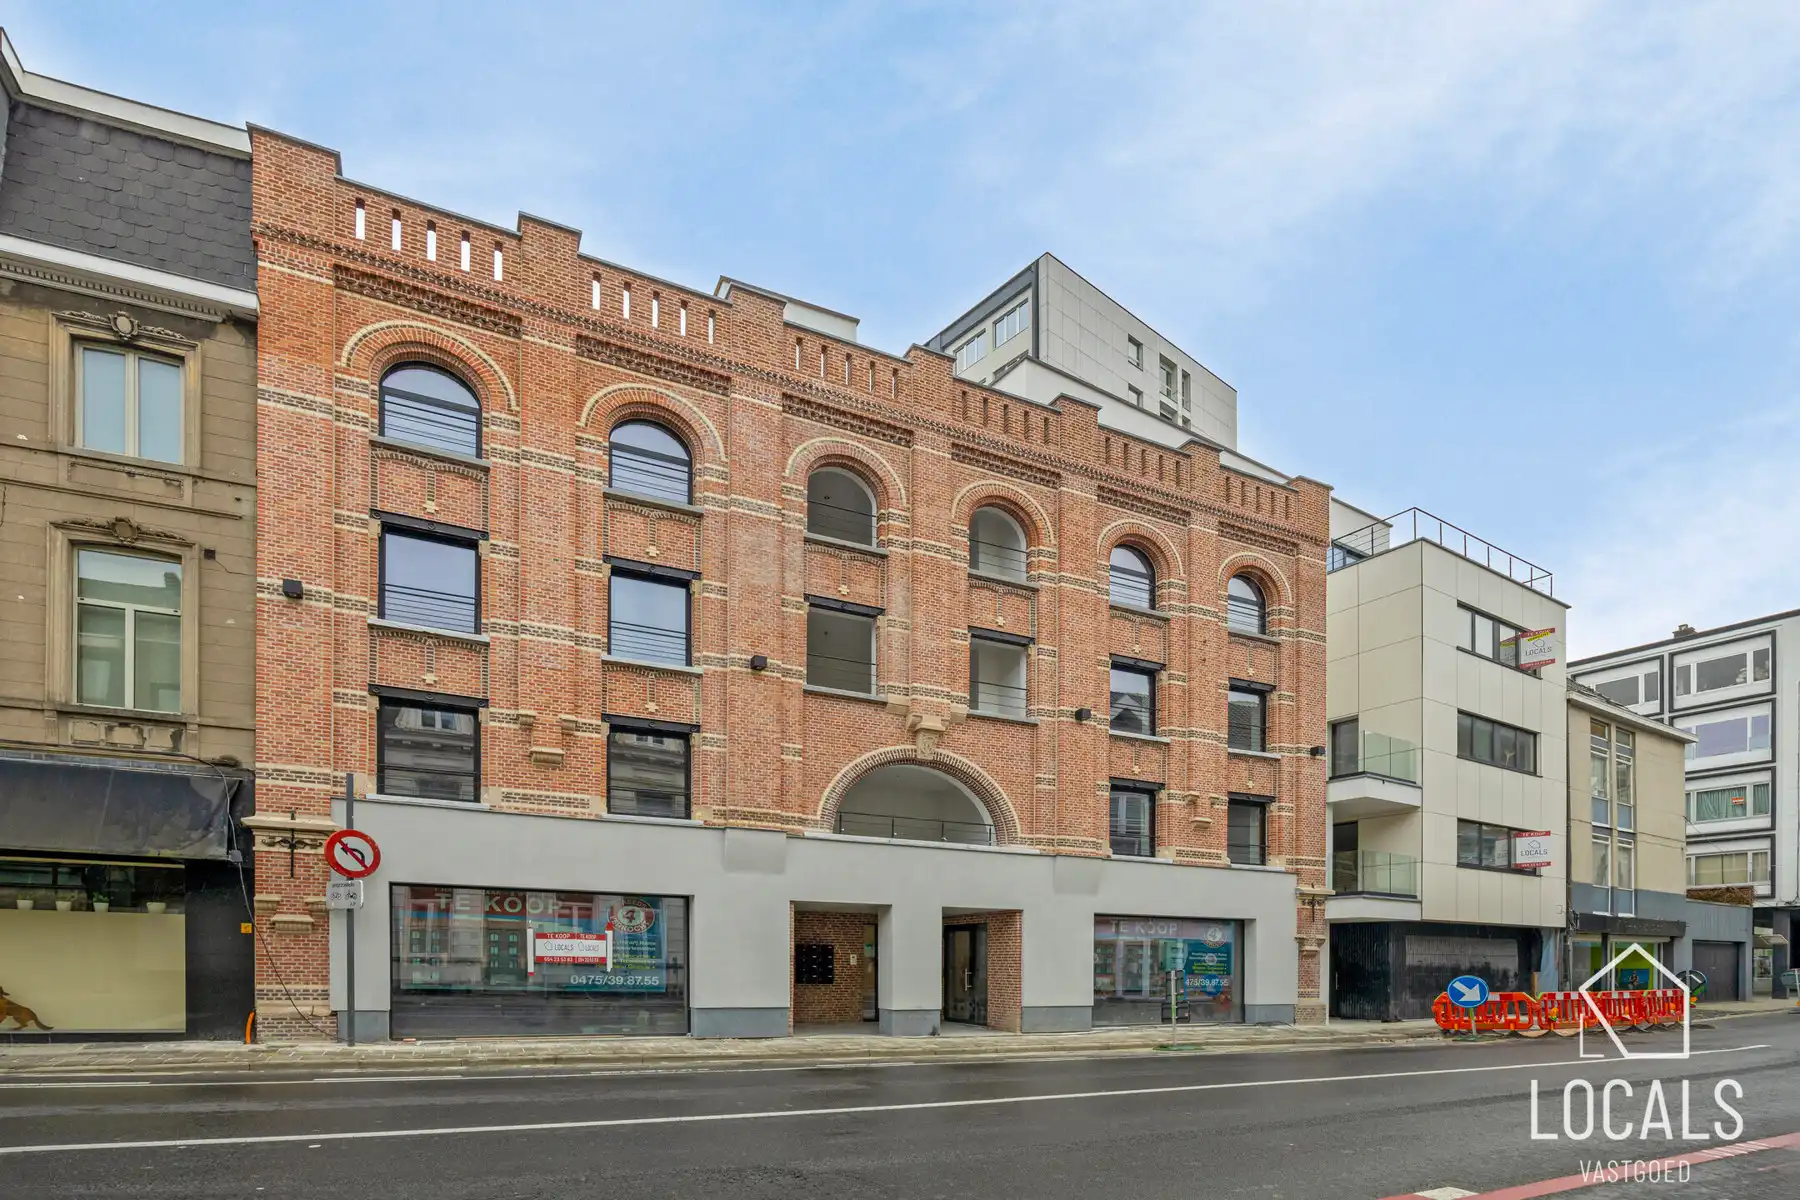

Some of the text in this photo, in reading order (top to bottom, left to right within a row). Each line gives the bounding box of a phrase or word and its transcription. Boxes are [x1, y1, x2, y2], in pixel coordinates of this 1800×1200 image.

[1525, 646, 1552, 656] LOCALS
[1520, 848, 1548, 857] LOCALS
[434, 893, 563, 915] TE KOOP
[1110, 921, 1177, 934] TE KOOP
[554, 943, 574, 951] LOCALS
[570, 975, 660, 986] 0475/39.87.55
[1185, 978, 1229, 987] 475/39.87.55
